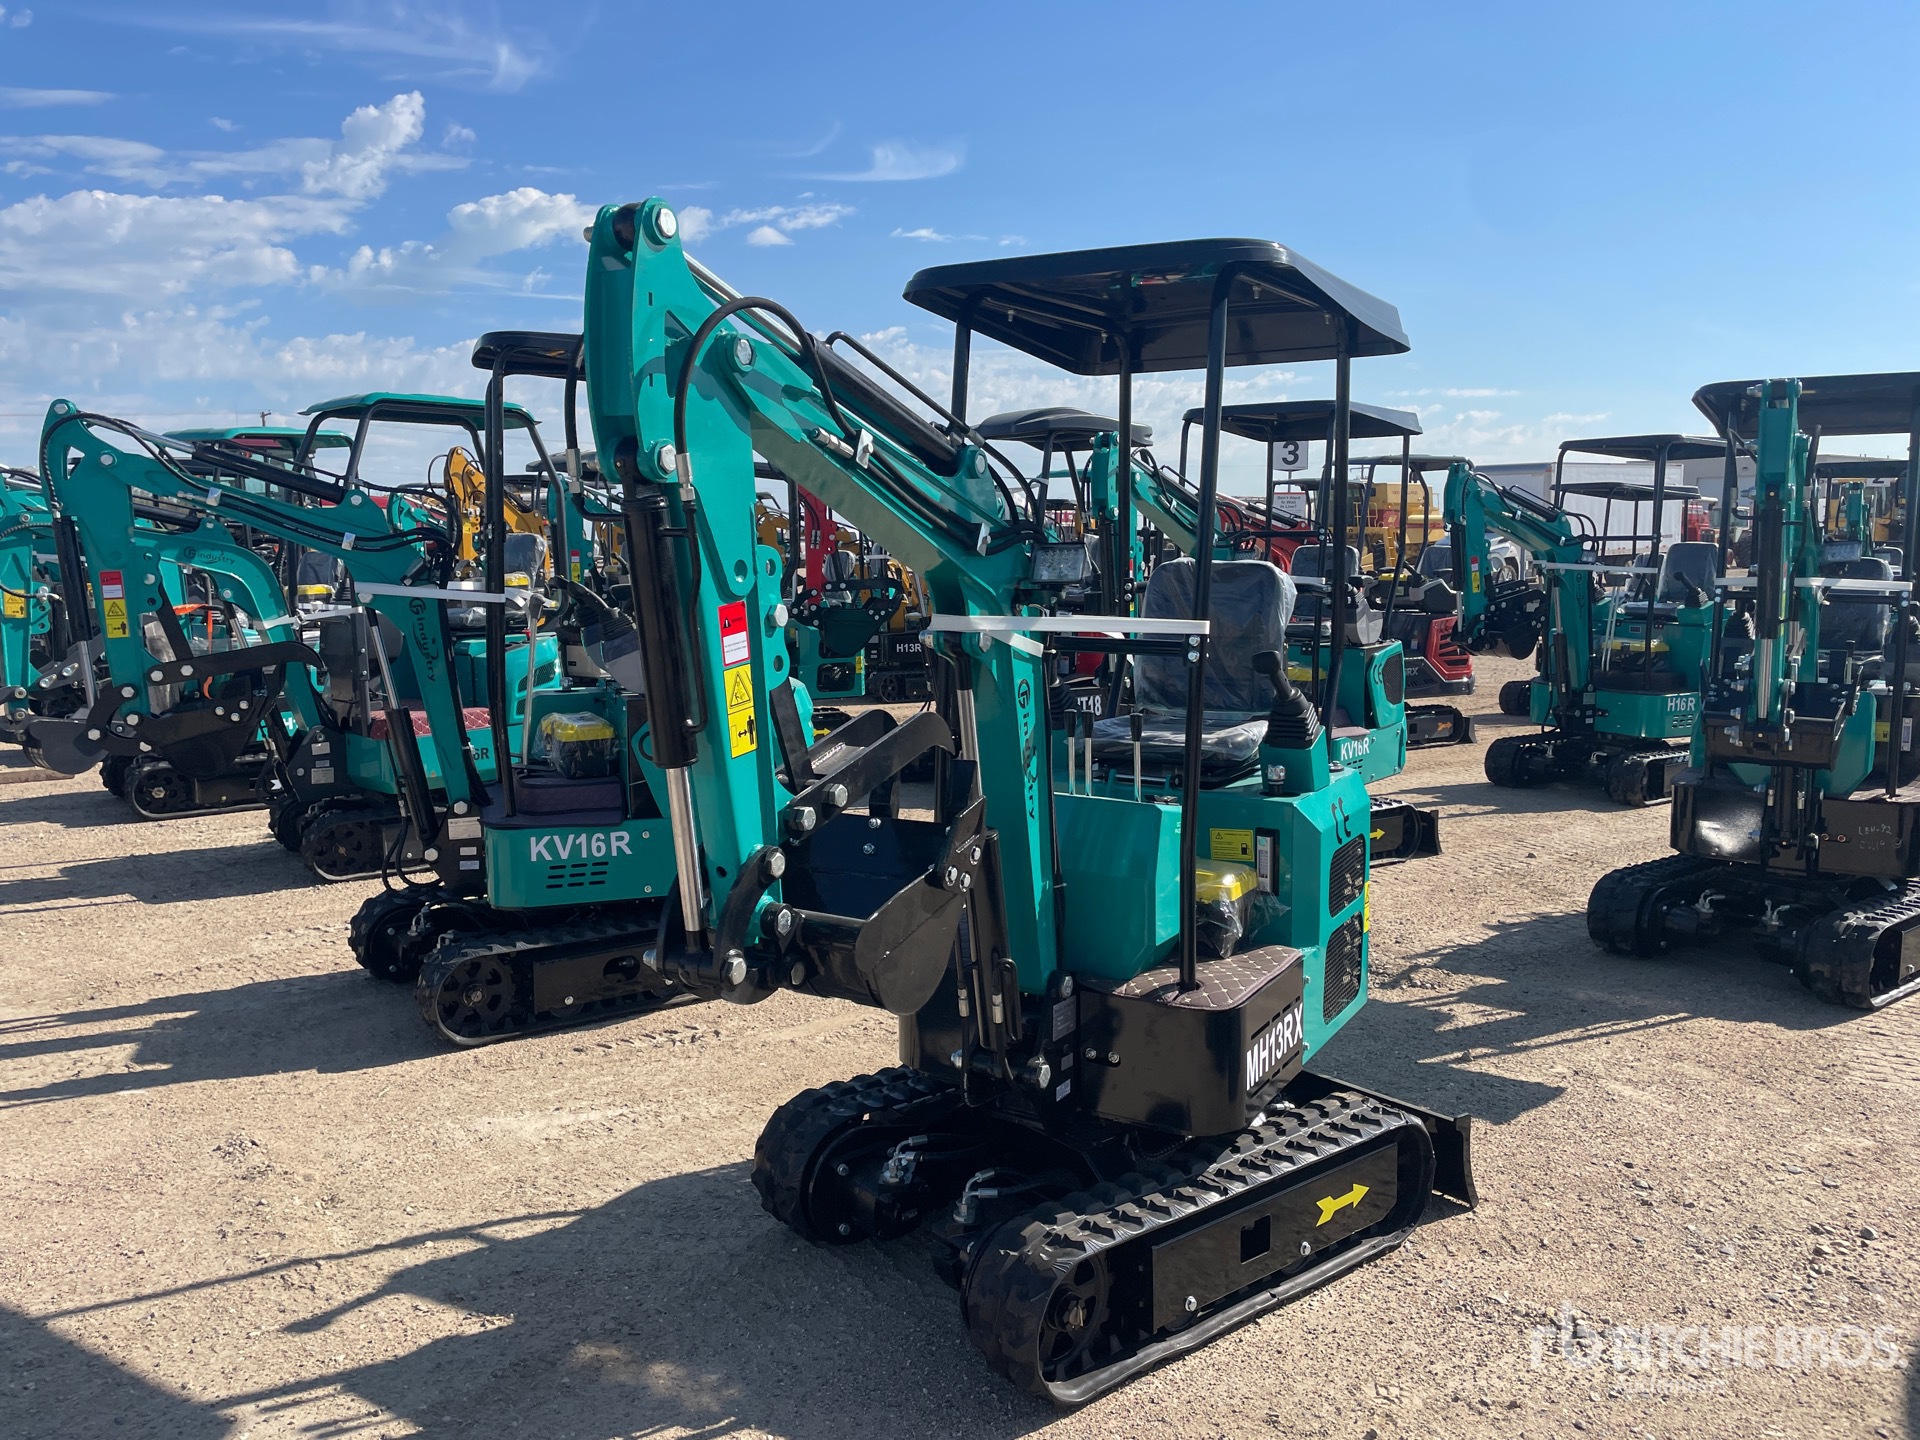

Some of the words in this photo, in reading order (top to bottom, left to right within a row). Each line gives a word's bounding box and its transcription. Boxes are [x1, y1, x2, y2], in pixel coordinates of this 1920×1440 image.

[1281, 440, 1300, 466] 3
[416, 617, 436, 682] industry
[896, 643, 922, 653] H13R
[1667, 697, 1696, 712] H16R
[1341, 737, 1370, 761] KV16R
[530, 831, 633, 862] KV16R
[1246, 1002, 1303, 1091] MH13RX
